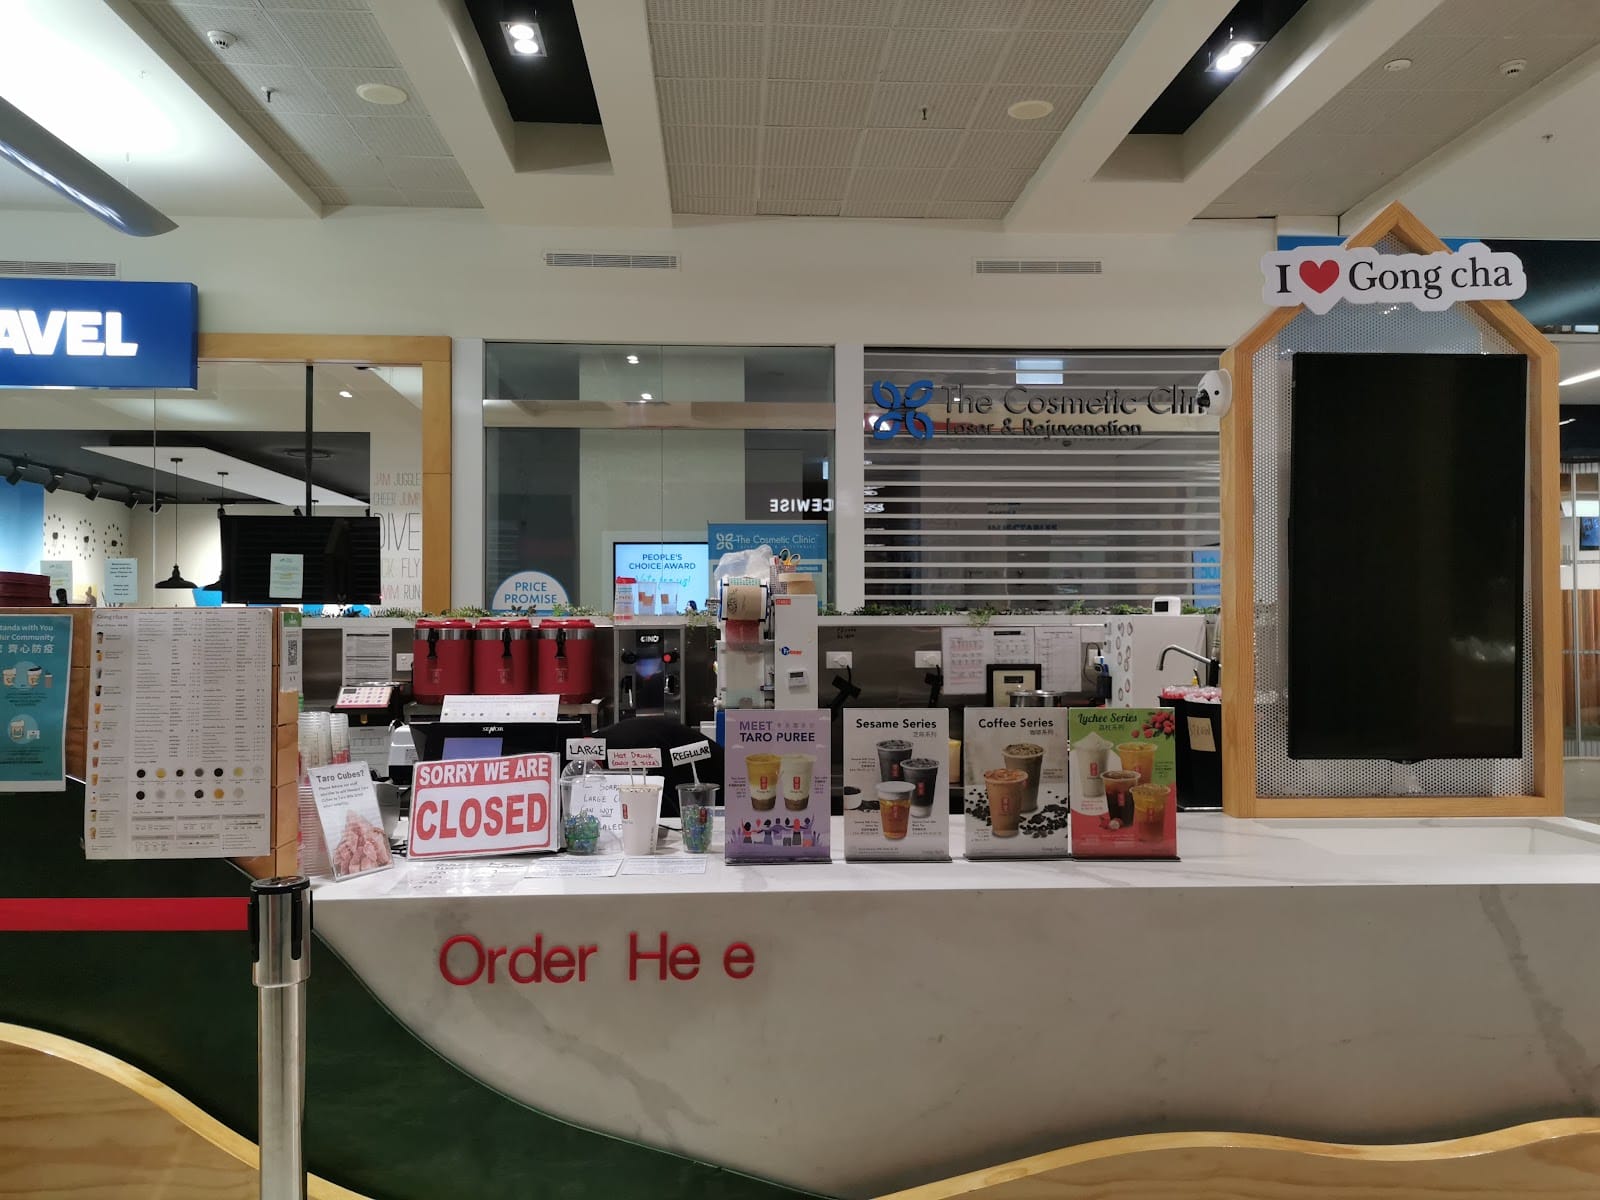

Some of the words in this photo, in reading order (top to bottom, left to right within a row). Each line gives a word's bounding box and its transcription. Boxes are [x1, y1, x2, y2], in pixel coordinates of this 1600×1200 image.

[1275, 264, 1293, 294] I
[1348, 261, 1443, 300] Gong
[1451, 257, 1513, 287] cha
[942, 384, 993, 414] The
[1003, 385, 1137, 414] Cosmetic
[945, 418, 995, 435] Laser
[1000, 418, 1014, 436] &
[1022, 418, 1142, 440] Rejuvenation
[736, 536, 750, 544] The
[753, 535, 790, 544] Cosmetic
[792, 535, 816, 544] Clinic
[642, 554, 683, 562] PEOPLE'S
[401, 557, 421, 578] FLY
[629, 562, 662, 570] CHOICE
[663, 562, 696, 570] AWARD
[515, 582, 547, 592] PRICE
[403, 585, 421, 600] RUN
[504, 594, 557, 604] PROMISE
[22, 624, 38, 632] with
[39, 624, 54, 632] You
[11, 633, 54, 642] Community
[856, 718, 899, 728] Sesame
[902, 718, 937, 728] Series
[978, 718, 1016, 728] Coffee
[1020, 718, 1054, 728] Series
[1078, 713, 1107, 725] Lychee
[1110, 713, 1138, 722] Series
[739, 721, 773, 731] MEET
[740, 732, 773, 742] TARO
[776, 732, 816, 742] PUREE
[569, 745, 605, 756] LARGE
[672, 746, 710, 761] REGULAR
[419, 763, 479, 785] SORRY
[484, 761, 510, 781] WE
[514, 757, 548, 779] ARE
[315, 775, 335, 783] Taro
[337, 770, 365, 780] Cubes?
[584, 794, 607, 803] LARGE
[600, 807, 614, 815] NOT
[416, 793, 548, 841] CLOSED
[438, 932, 598, 986] Order
